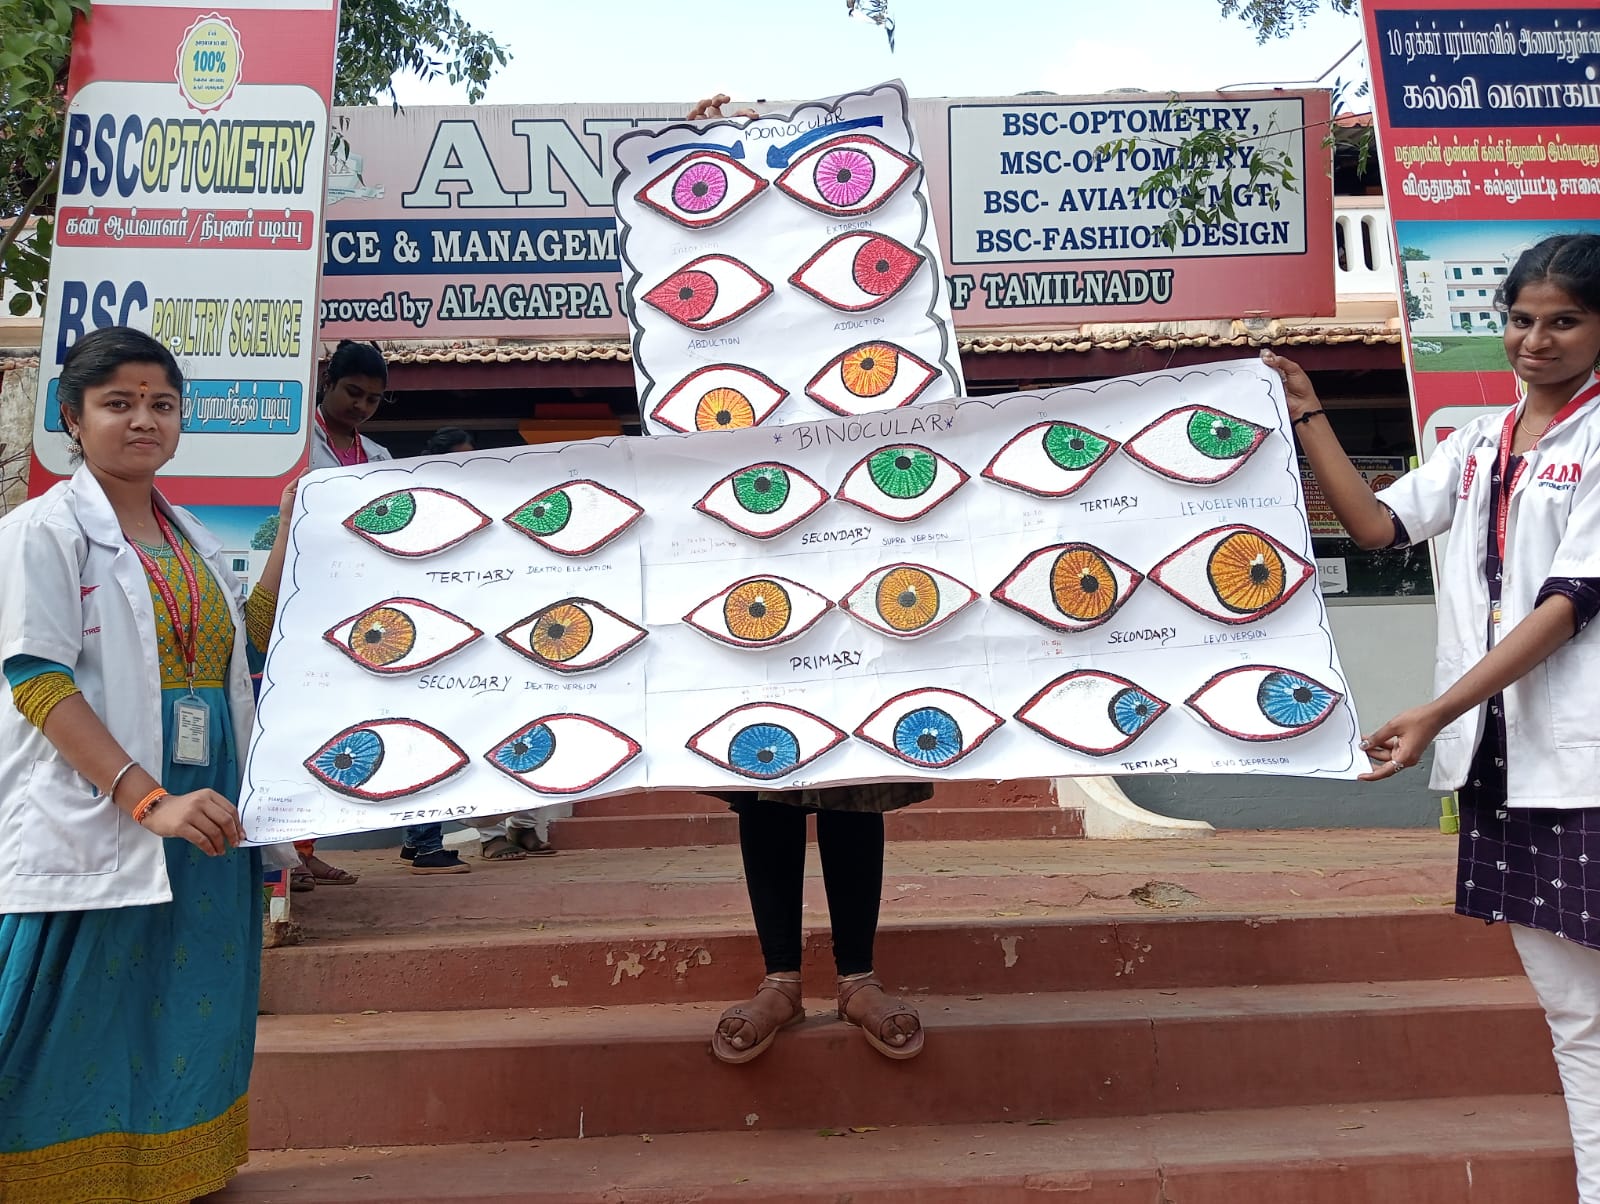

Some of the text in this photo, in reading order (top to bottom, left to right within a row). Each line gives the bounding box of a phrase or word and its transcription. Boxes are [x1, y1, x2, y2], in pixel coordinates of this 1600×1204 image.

[1386, 28, 1402, 56] 10
[193, 50, 226, 73] 100%
[1402, 74, 1482, 110] கல்வி
[744, 106, 846, 142] MONOCULAR
[61, 113, 315, 198] BSC OPTOMETRY
[66, 205, 99, 236] கண்
[258, 208, 302, 243] படிப்பு
[1181, 221, 1290, 247] DESIGN
[393, 230, 420, 264] &
[432, 228, 619, 263] MANAGEM
[980, 268, 1175, 309] TAMILNADU
[398, 291, 433, 328] by
[437, 282, 612, 322] ALAGAPPA
[151, 298, 228, 356] POULTRY
[229, 298, 302, 358] SCIENCE
[833, 316, 885, 332] ADDUCTION
[687, 336, 740, 350] ABDUCTION
[792, 412, 944, 452] BINOCULAR
[1080, 495, 1139, 514] TERTIARY
[801, 526, 872, 546] SECONDARY
[426, 568, 515, 588] TERTIARY
[1318, 565, 1339, 575] FICE
[1107, 626, 1177, 646] SECONDARY
[1230, 628, 1268, 642] VERSION
[789, 650, 863, 671] PRIMARY
[417, 675, 513, 696] SECONDARY
[1120, 757, 1179, 772] TERTIARY
[389, 804, 479, 822] TERTIARY
